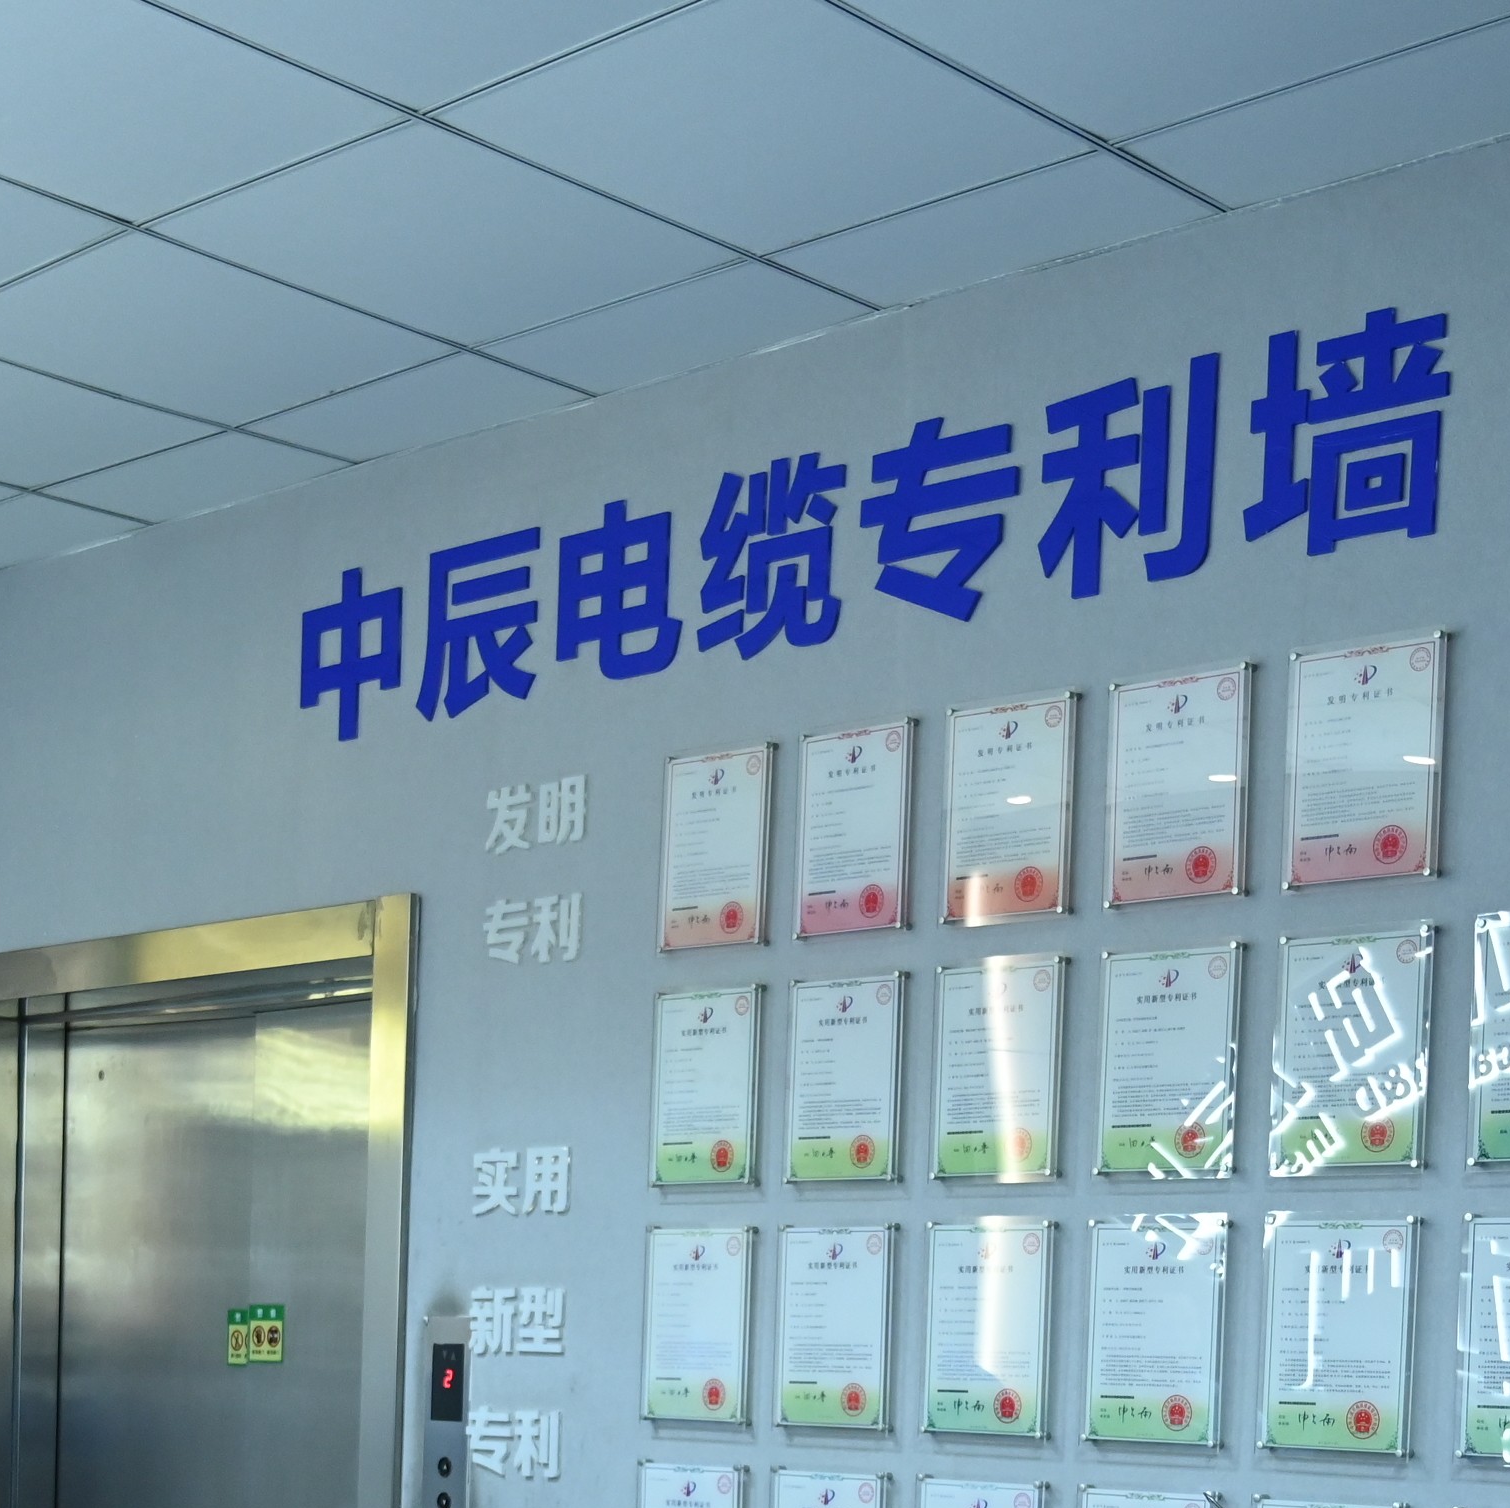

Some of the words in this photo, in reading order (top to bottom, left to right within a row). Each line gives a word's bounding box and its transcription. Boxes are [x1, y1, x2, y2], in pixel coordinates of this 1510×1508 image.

[300, 307, 1451, 741] 中辰电缆专利墙
[485, 775, 587, 855] 发明
[482, 892, 583, 965] 专利
[471, 1147, 572, 1216] 实用
[468, 1286, 566, 1356] 新型
[442, 1368, 455, 1389] 2
[465, 1405, 562, 1481] 专利
